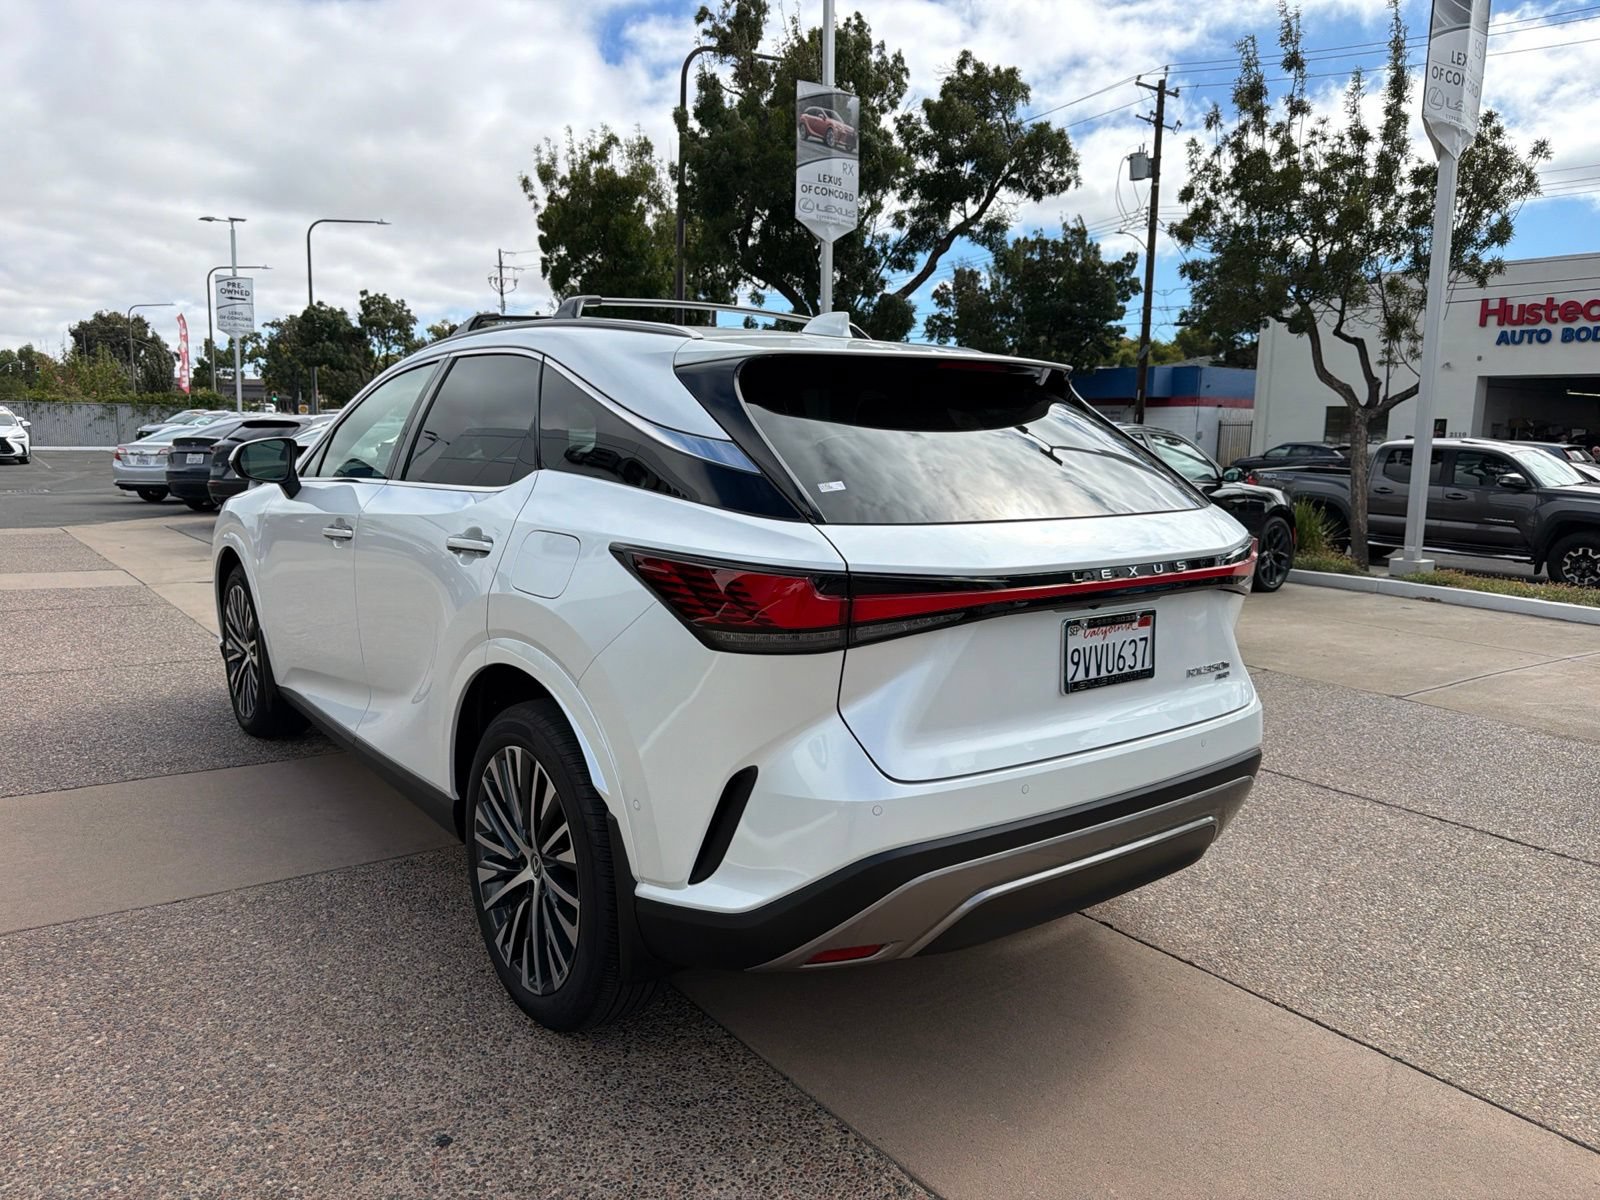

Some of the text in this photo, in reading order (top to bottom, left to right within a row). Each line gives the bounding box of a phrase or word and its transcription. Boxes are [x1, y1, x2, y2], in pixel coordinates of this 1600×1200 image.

[1451, 50, 1473, 73] LEXS
[1432, 66, 1444, 80] OF
[842, 162, 854, 176] RX
[817, 173, 842, 187] LEXUS
[801, 184, 854, 202] OF CONCORD
[816, 203, 856, 218] LEXUS
[220, 288, 250, 296] OWNED
[1496, 328, 1552, 345] AUTO
[1072, 561, 1187, 582] LEXUS
[1069, 637, 1149, 681] 9VVU637
